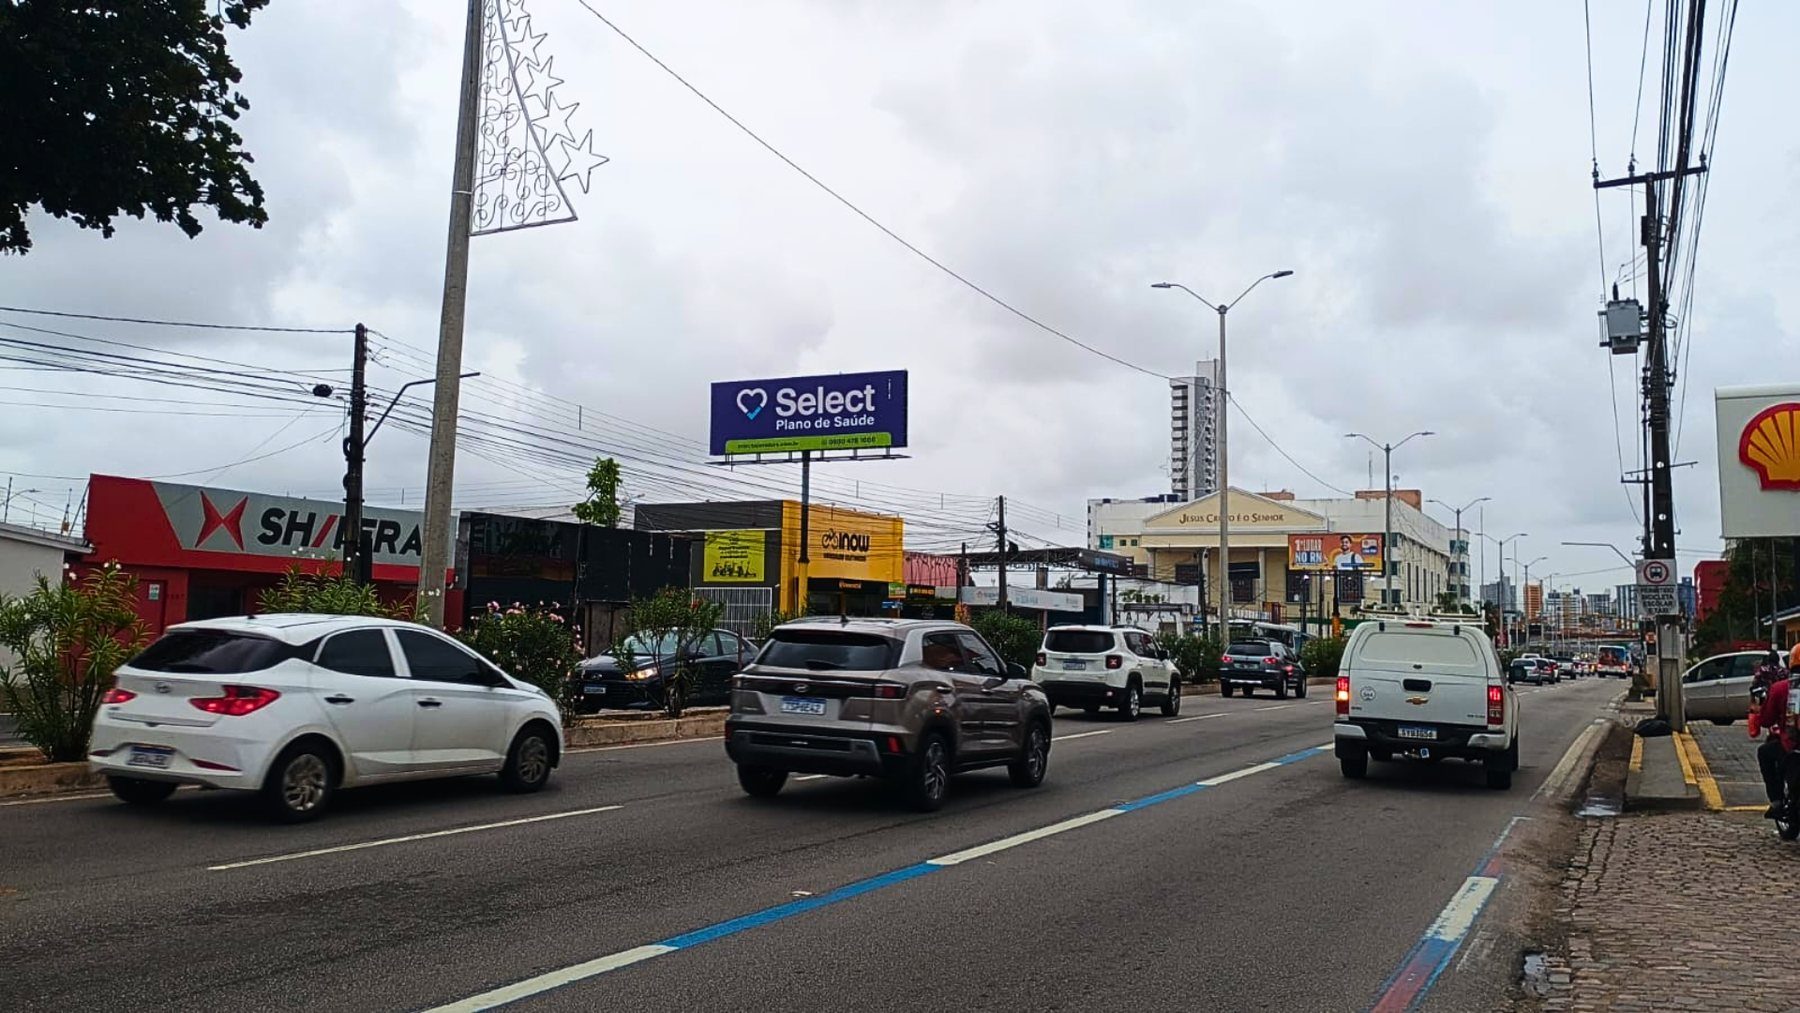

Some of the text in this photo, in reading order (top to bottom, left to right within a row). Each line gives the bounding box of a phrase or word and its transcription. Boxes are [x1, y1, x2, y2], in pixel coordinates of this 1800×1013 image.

[775, 384, 875, 417] Select
[776, 414, 875, 431] Plano de Saúde
[1252, 513, 1284, 523] SENHOR
[1295, 551, 1322, 563] NO RN
